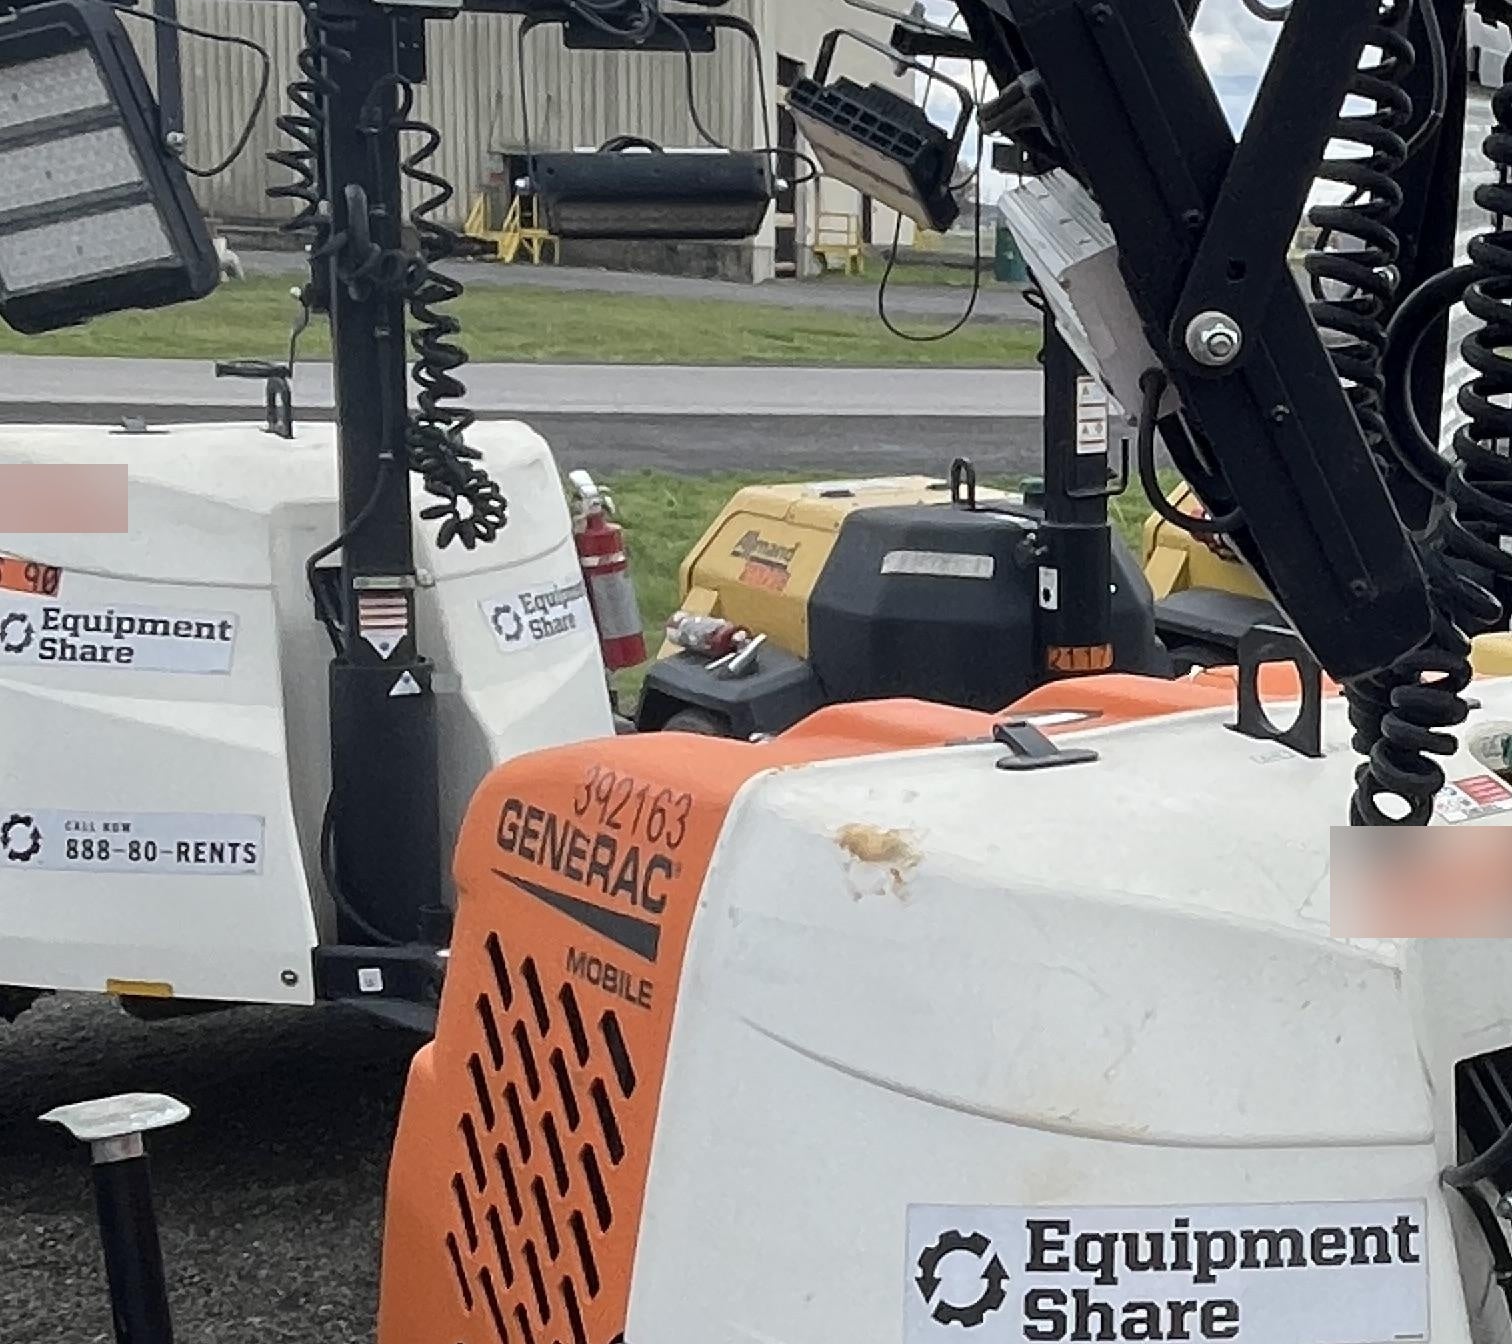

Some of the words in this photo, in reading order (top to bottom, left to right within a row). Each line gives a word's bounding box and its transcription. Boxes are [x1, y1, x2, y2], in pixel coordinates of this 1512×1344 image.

[38, 637, 134, 663] Share
[41, 607, 232, 641] Equipment
[573, 766, 693, 850] 392163
[66, 838, 257, 865] 888-80-RENTS
[496, 797, 674, 914] GENERAC
[566, 946, 654, 1011] MOBILE
[1024, 1216, 1420, 1286] Equipment
[1022, 1288, 1240, 1343] Share
